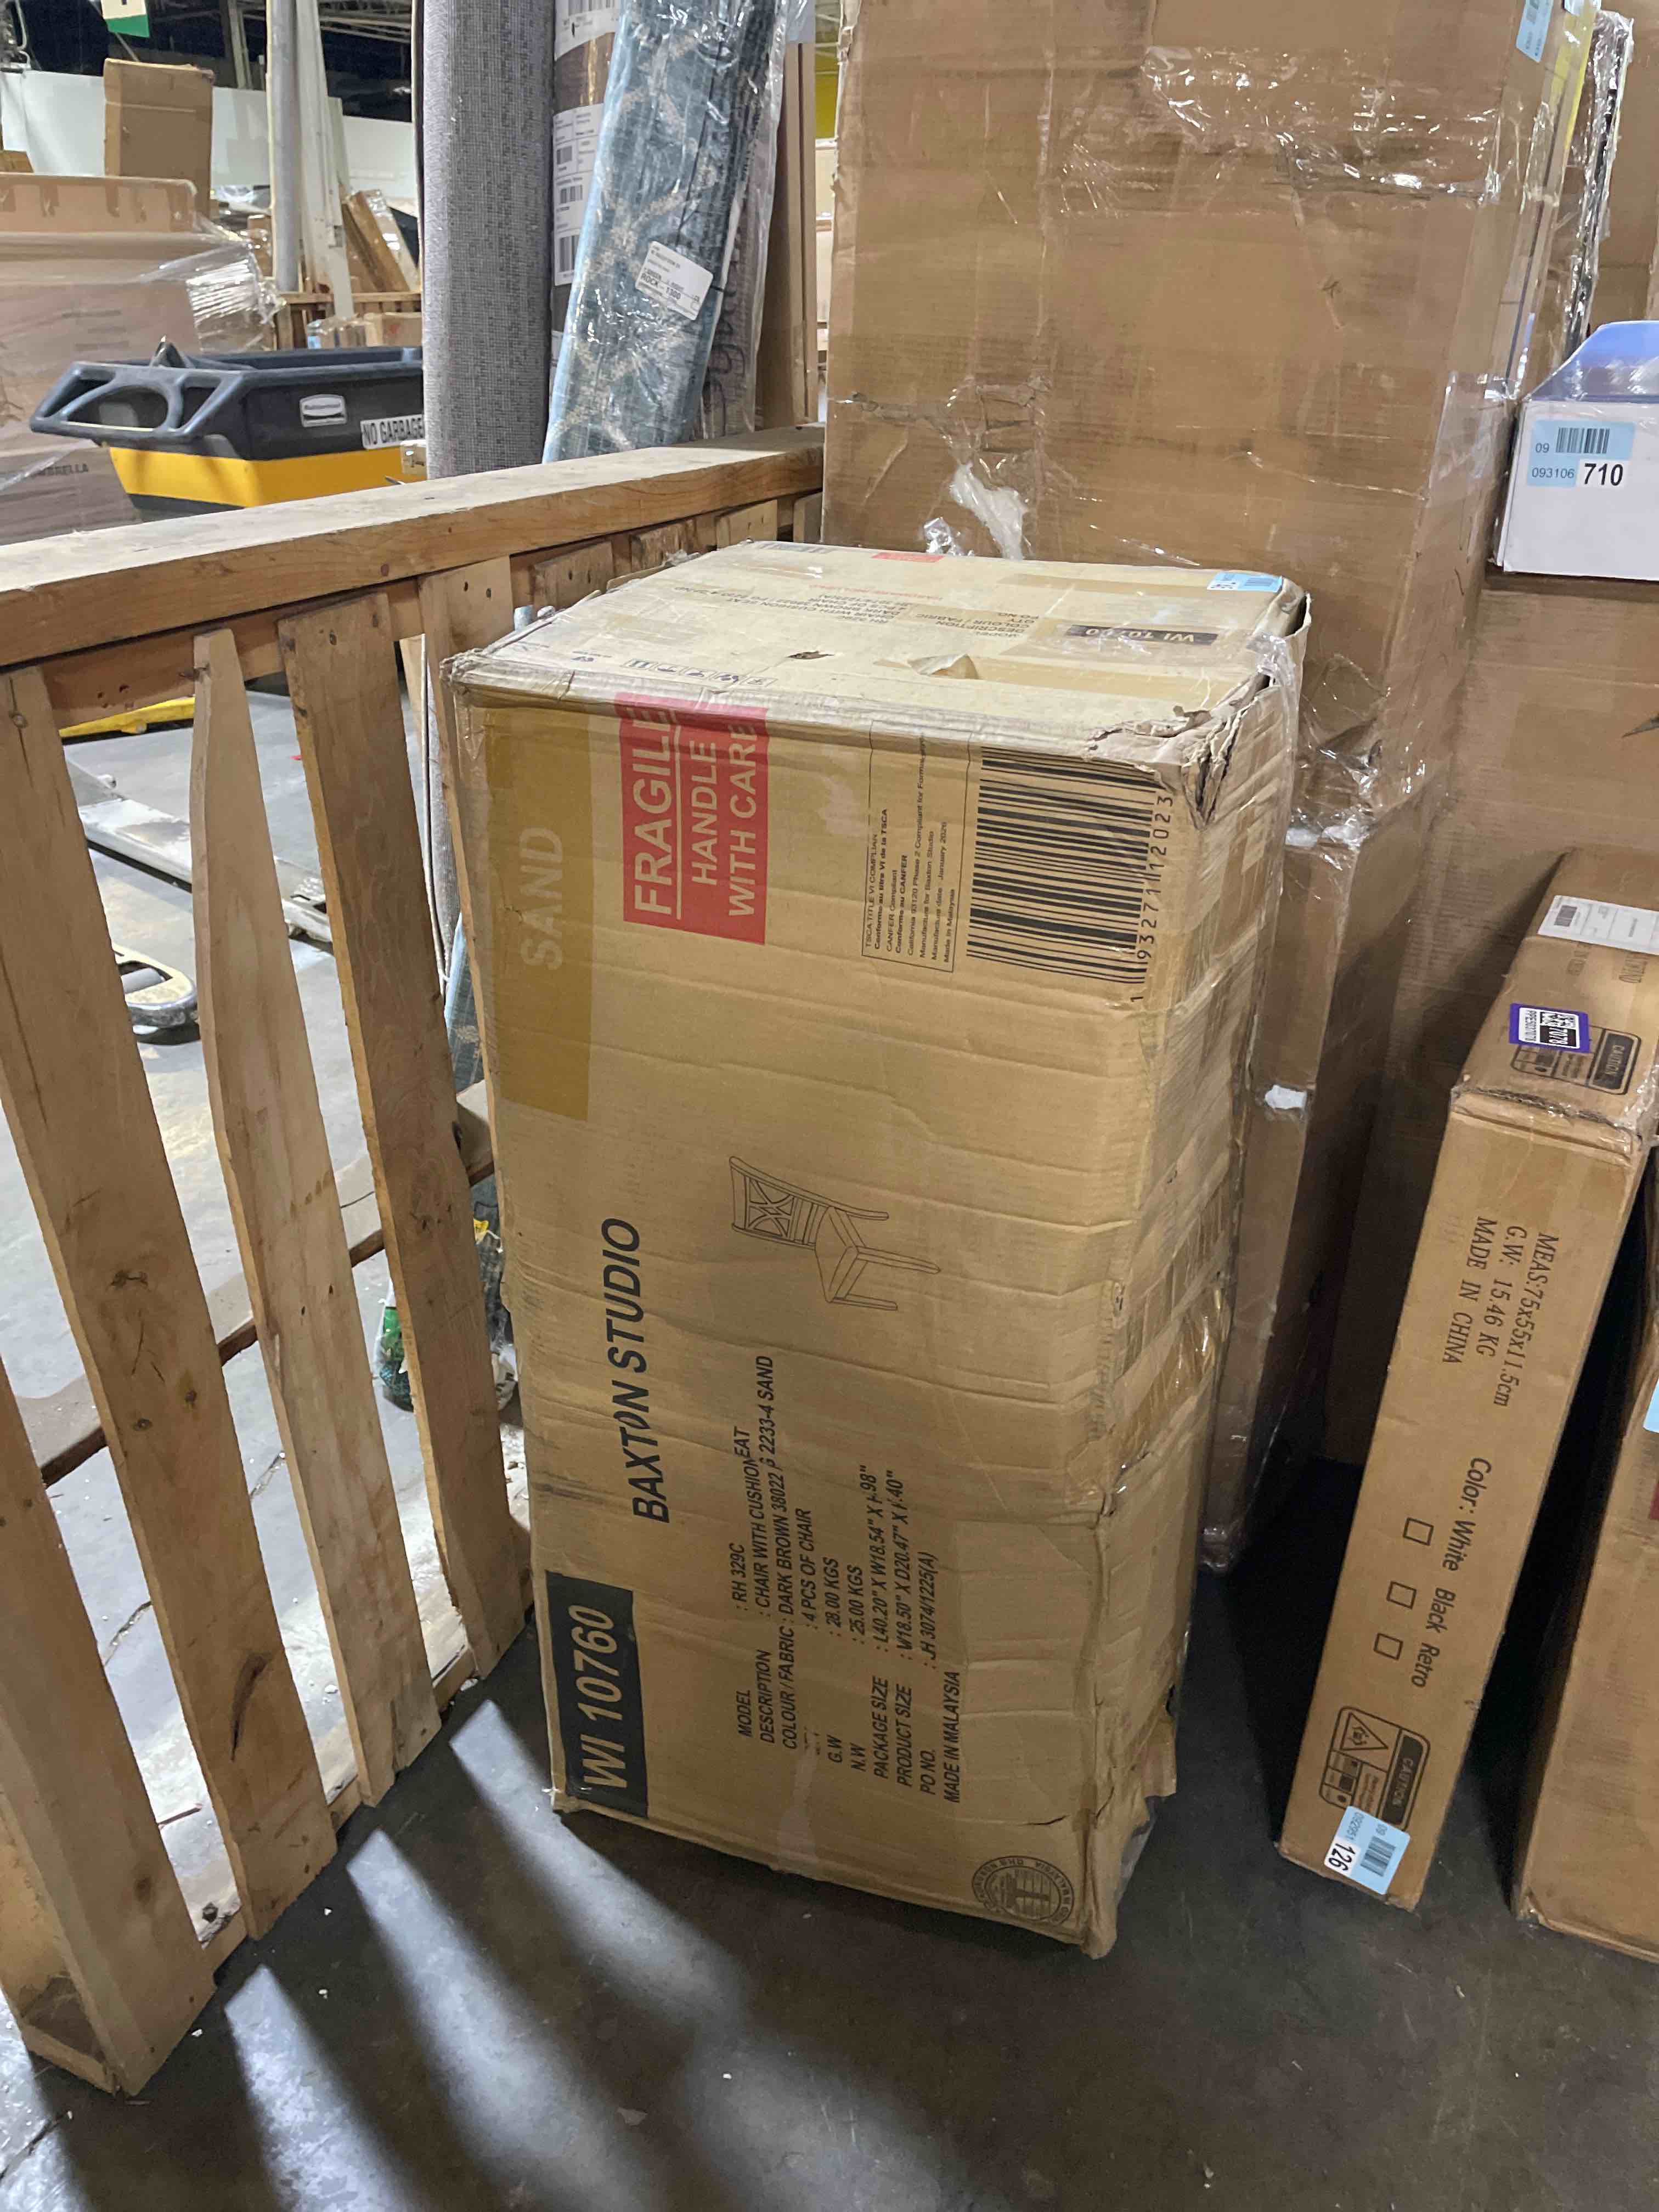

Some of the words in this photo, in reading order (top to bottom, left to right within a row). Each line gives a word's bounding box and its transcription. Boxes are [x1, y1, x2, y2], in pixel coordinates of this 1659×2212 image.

[362, 422, 377, 446] NO
[1535, 442, 1550, 453] 09
[1531, 467, 1575, 479] 093106
[1583, 462, 1623, 487] 710
[936, 621, 1024, 633] DESCRIPTION
[1163, 633, 1195, 642] WI
[727, 724, 757, 819] CARE
[627, 710, 673, 915] FRAGILE
[690, 740, 718, 885] HANDLE
[728, 829, 756, 916] WITH
[879, 861, 885, 870] VI
[907, 917, 916, 956] California
[915, 805, 923, 849] Compliant
[938, 847, 946, 881] January
[518, 828, 563, 970] SAND
[868, 885, 875, 894] VI
[889, 870, 898, 911] Compliant
[900, 896, 905, 907] au
[946, 889, 955, 927] Malaysia
[887, 913, 895, 952] CANFER
[1549, 1028, 1568, 1045] 7078
[1466, 1216, 1497, 1270] MADE
[1499, 1225, 1527, 1266] G.W:
[601, 1218, 647, 1373] STUDIO
[1459, 1279, 1481, 1302] IN
[1483, 1278, 1513, 1327] 15.46
[1442, 1311, 1473, 1364] CHINA
[1493, 1232, 1559, 1407] MEAS:75x55x11.5cm
[1476, 1331, 1500, 1357] KG
[755, 1356, 774, 1401] SAND
[733, 1426, 751, 1458] EAT
[758, 1404, 775, 1454] 2233-4
[611, 1379, 670, 1523] BAXTON
[742, 1457, 764, 1520] CUSHION
[768, 1472, 787, 1513] 38022
[1459, 1457, 1492, 1514] Color:
[795, 1508, 814, 1551] CHAIR
[866, 1505, 883, 1517] X
[891, 1511, 909, 1525] X
[751, 1521, 769, 1558] WITH
[773, 1514, 792, 1570] BROWN
[1442, 1520, 1476, 1572] White
[729, 1543, 746, 1578] 329C
[799, 1554, 815, 1576] OF
[823, 1556, 840, 1590] KGS
[847, 1564, 864, 1596] KGS
[732, 1581, 747, 1602] RH
[753, 1562, 770, 1608] CHAIR
[777, 1572, 794, 1615] DARK
[800, 1579, 816, 1610] PCS
[871, 1579, 887, 1590] X
[894, 1581, 911, 1592] X
[917, 1551, 938, 1639] 3074/1225(A)
[800, 1612, 816, 1621] 4
[824, 1592, 842, 1628] 28.00
[848, 1599, 865, 1635] 25.00
[1425, 1587, 1456, 1633] Black
[568, 1605, 623, 1721] 10760
[778, 1626, 795, 1681] FABRIC
[921, 1640, 936, 1660] JH
[1411, 1643, 1440, 1689] Retro
[736, 1689, 753, 1737] MODEL
[755, 1650, 775, 1743] DESCRIPTION
[870, 1676, 888, 1711] SIZE
[895, 1684, 912, 1718] SIZE
[943, 1672, 960, 1743] MALAYSIA
[780, 1690, 797, 1749] COLOUR
[580, 1734, 627, 1788] WI
[827, 1734, 843, 1763] G.W
[850, 1742, 866, 1771] N.W
[872, 1711, 889, 1779] PACKAGE
[895, 1719, 912, 1787] PRODUCT
[919, 1749, 936, 1773] NO.
[943, 1745, 960, 1760] IN
[919, 1774, 936, 1795] PO
[943, 1762, 960, 1804] MADE
[1328, 1843, 1356, 1871] 126
